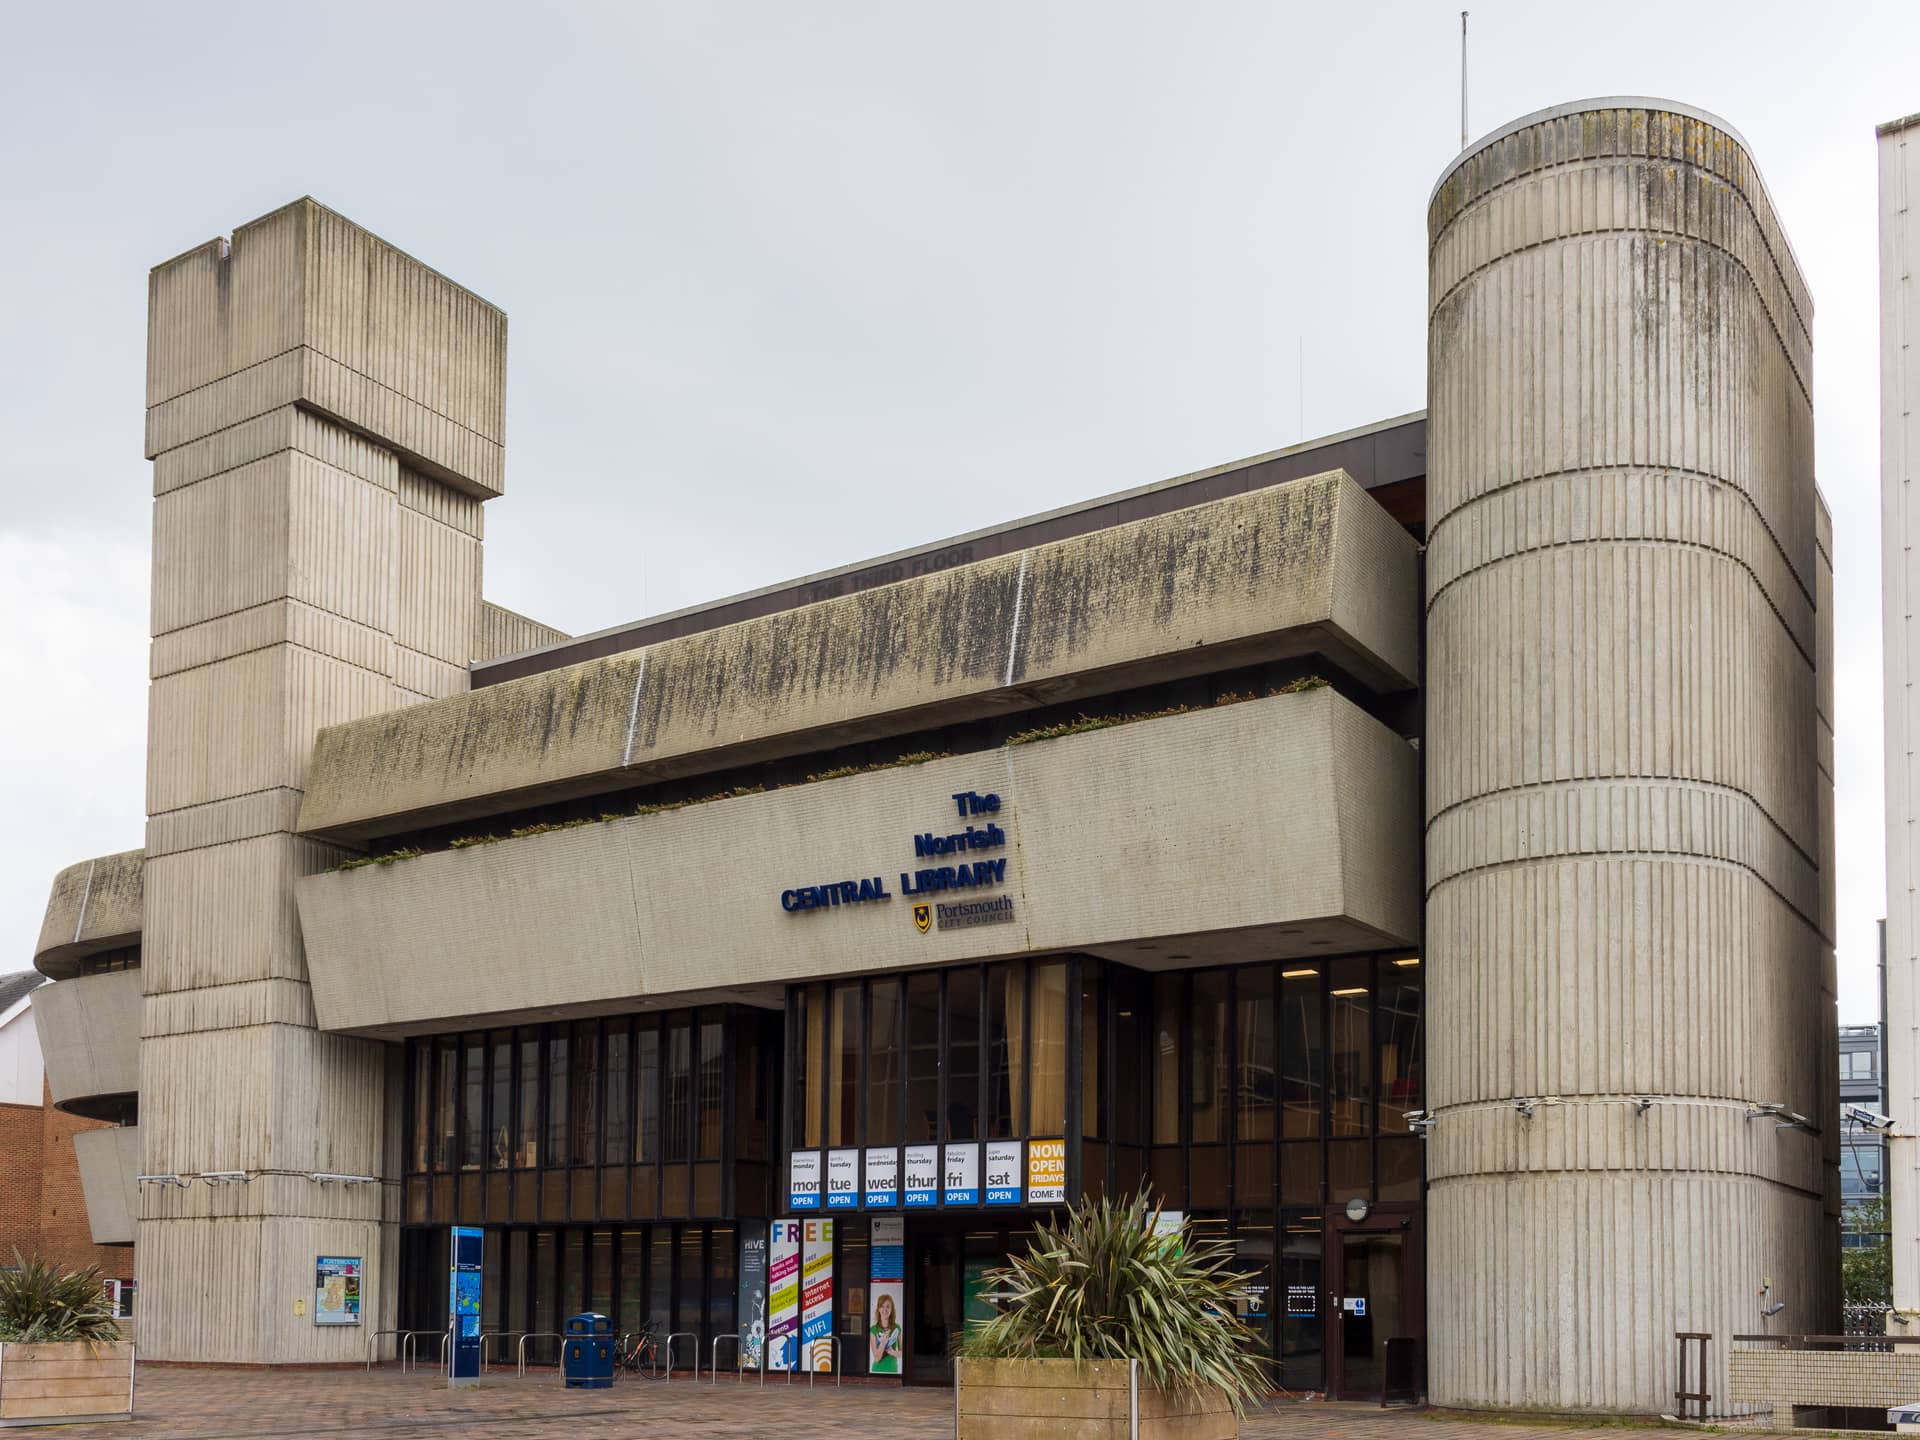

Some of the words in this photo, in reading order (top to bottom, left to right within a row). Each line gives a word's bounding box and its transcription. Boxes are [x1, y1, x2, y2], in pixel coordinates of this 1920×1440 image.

[853, 564, 904, 591] THIRD
[911, 546, 974, 576] FLOOR
[952, 791, 1001, 817] The
[914, 823, 1005, 857] Norrish
[781, 877, 891, 912] CENTRAL
[900, 858, 1007, 896] LIBRARY
[936, 894, 1013, 920] Portsmouth
[937, 918, 961, 929] CITY
[966, 911, 1014, 925] COUNCIL
[988, 1153, 1015, 1162] saturday
[1030, 1144, 1064, 1159] NOW
[830, 1160, 851, 1169] tuesday
[906, 1157, 932, 1165] thursday
[947, 1155, 965, 1164] friday
[793, 1162, 815, 1170] monday
[1030, 1159, 1064, 1173] OPEN
[830, 1178, 851, 1190] tue
[868, 1175, 897, 1189] wed
[906, 1174, 936, 1188] thur
[947, 1172, 963, 1187] fri
[988, 1171, 1010, 1186] sat
[1030, 1174, 1064, 1184] FRIDAYS
[829, 1195, 850, 1204] OPEN
[868, 1194, 889, 1204] OPEN
[906, 1193, 929, 1202] OPEN
[947, 1192, 969, 1201] OPEN
[988, 1191, 1011, 1201] OPEN
[1030, 1189, 1055, 1199] COME
[792, 1196, 813, 1206] OPEN
[744, 1239, 765, 1250] HIVE
[804, 1281, 830, 1298] Internet
[804, 1293, 825, 1306] access
[804, 1320, 827, 1338] WIFI
